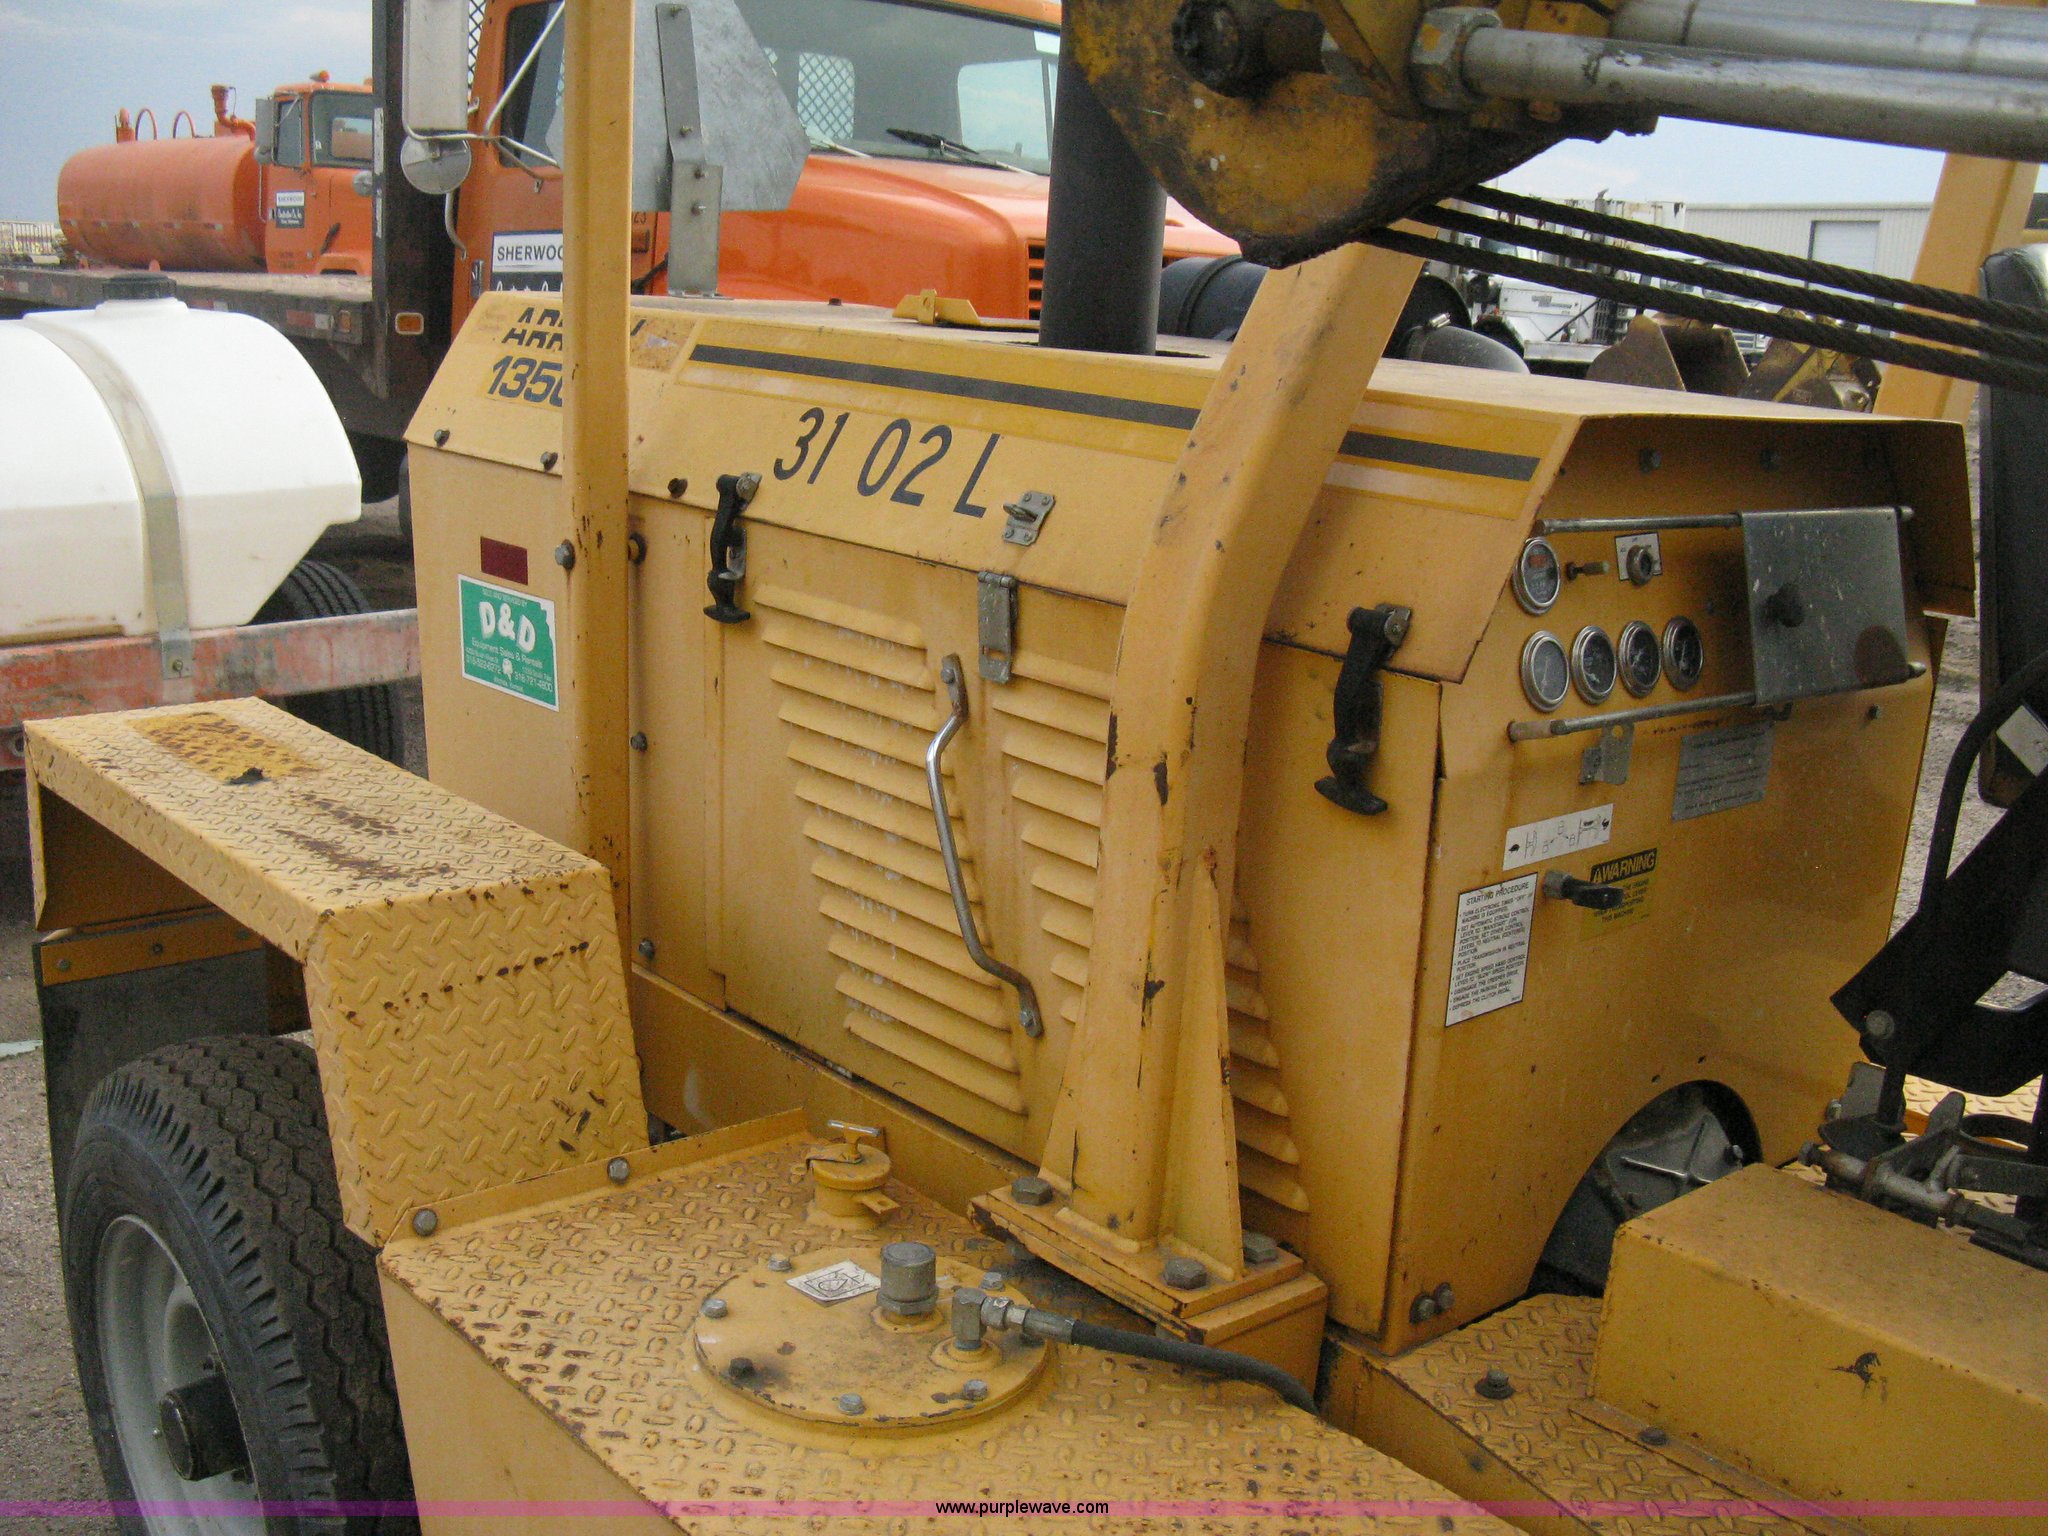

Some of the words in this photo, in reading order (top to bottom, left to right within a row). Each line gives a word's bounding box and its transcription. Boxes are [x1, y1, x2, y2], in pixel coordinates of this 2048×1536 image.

[497, 244, 563, 261] SHERWO
[773, 407, 850, 484] 31
[857, 418, 952, 507] 02
[953, 433, 1000, 518] L
[1602, 852, 1655, 881] WARNING
[1466, 891, 1493, 905] STARTING
[1496, 882, 1529, 896] PROCEDURE
